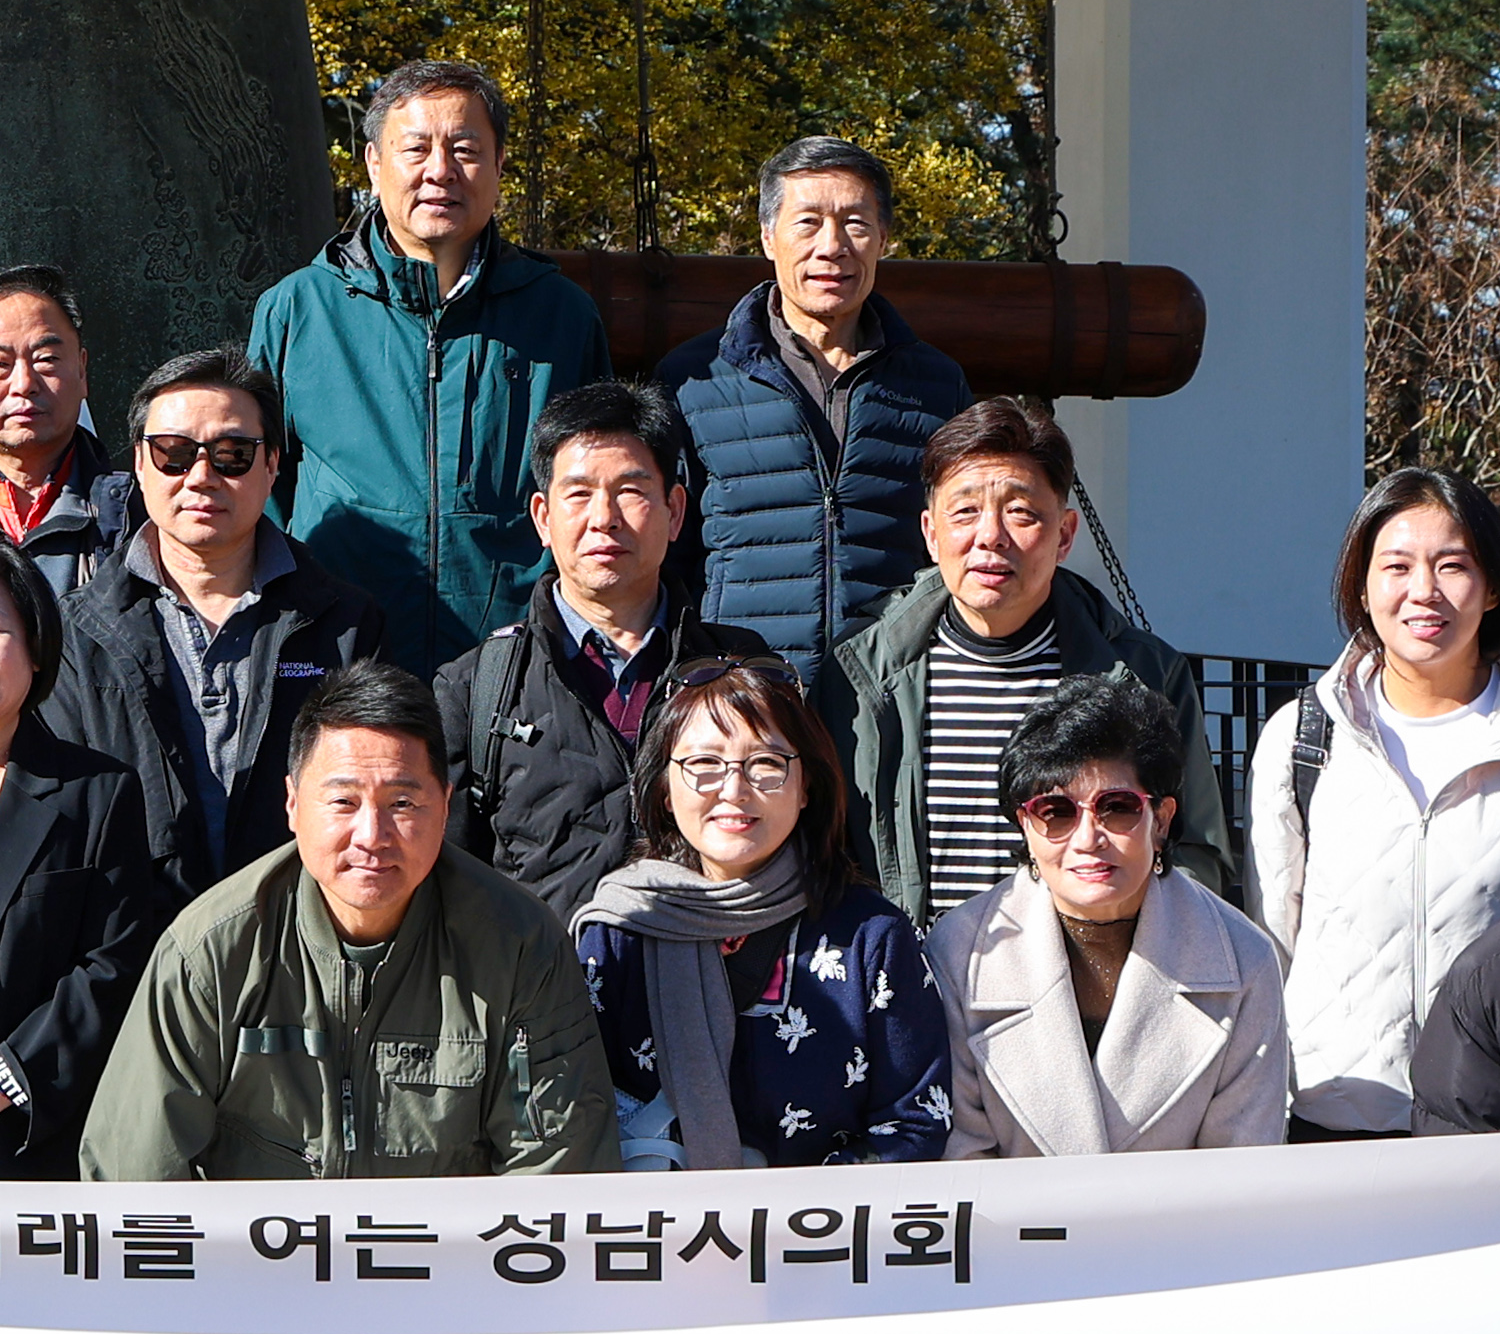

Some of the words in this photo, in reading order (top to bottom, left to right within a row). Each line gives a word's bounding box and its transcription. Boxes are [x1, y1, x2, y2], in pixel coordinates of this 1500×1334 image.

[279, 667, 325, 677] GEOGRAPHIC
[386, 1041, 434, 1063] Jeep
[250, 1215, 438, 1281] 여는
[478, 1202, 972, 1284] 성남시의회
